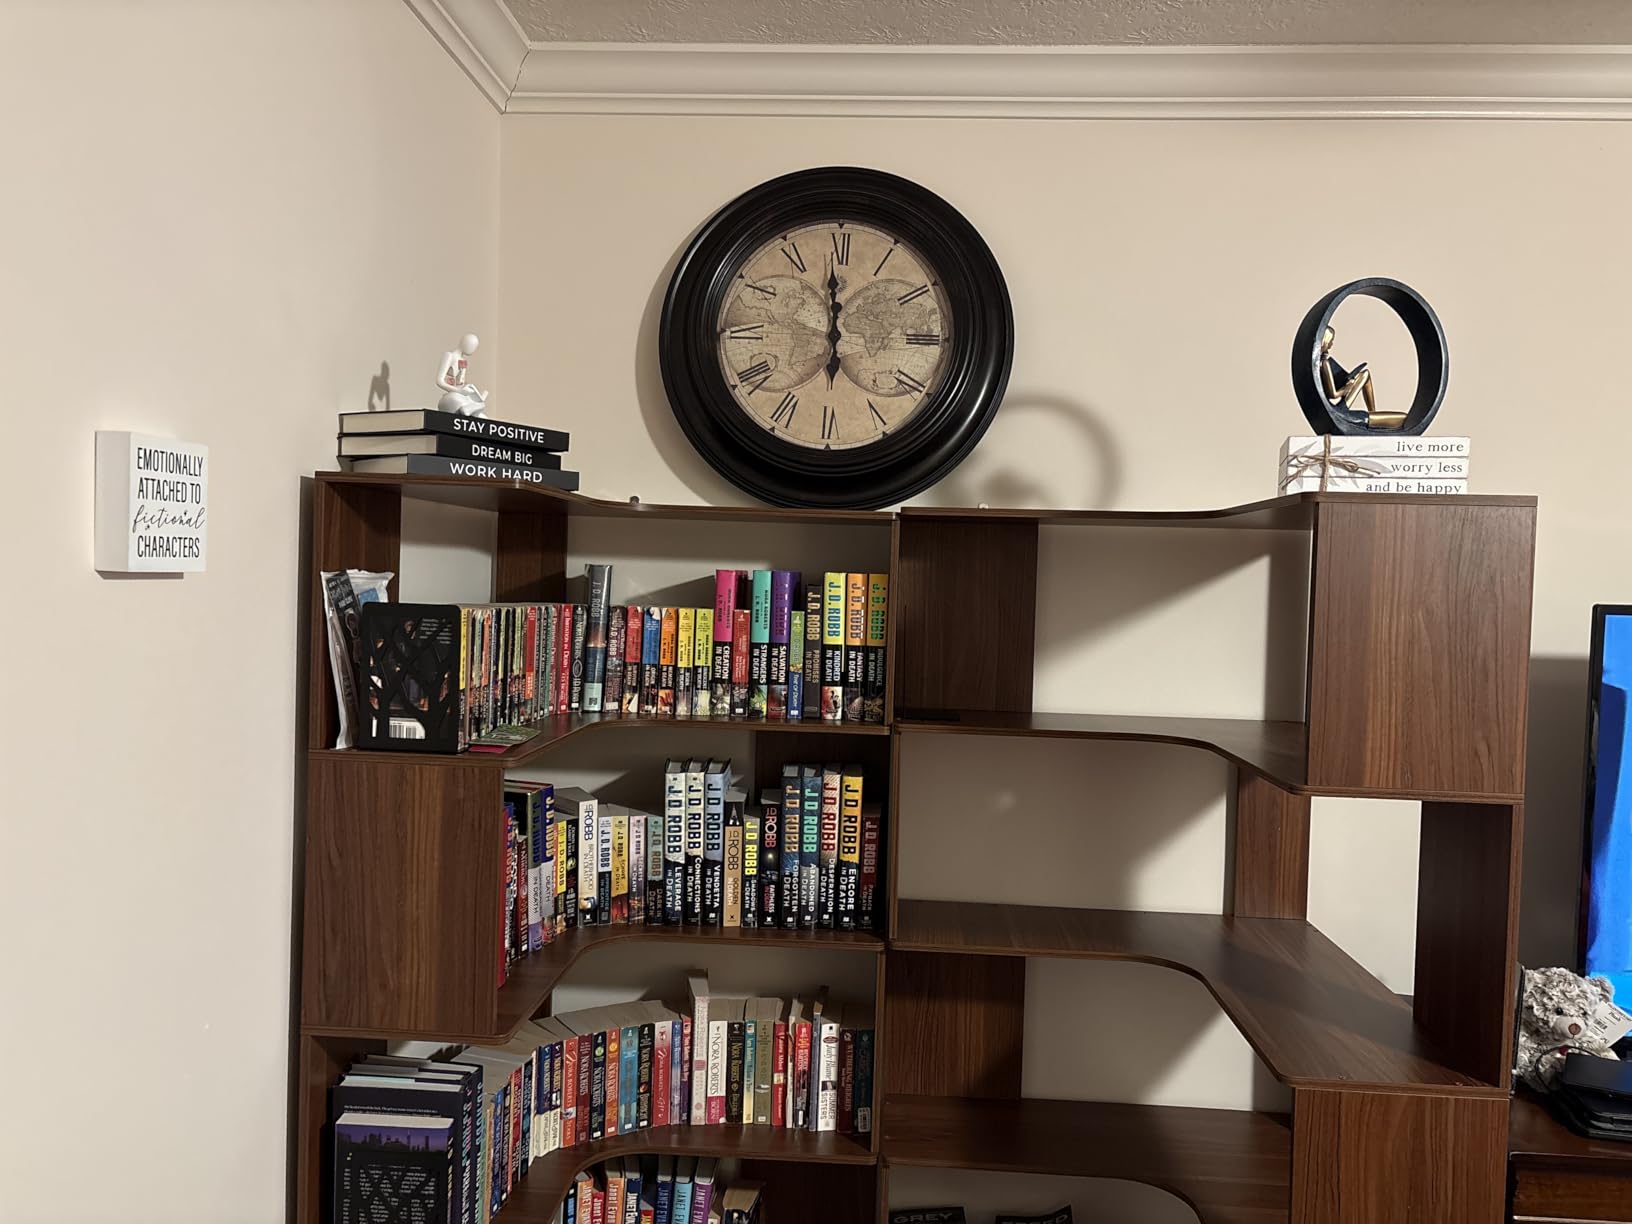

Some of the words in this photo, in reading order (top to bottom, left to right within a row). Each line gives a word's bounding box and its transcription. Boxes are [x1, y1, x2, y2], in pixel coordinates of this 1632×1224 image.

[906, 334, 940, 345] III
[453, 418, 484, 433] STAY
[489, 424, 545, 443] POSITIVE
[472, 444, 511, 461] DREAM
[514, 452, 533, 465] BIG
[1397, 441, 1423, 452] live
[1427, 444, 1464, 452] more
[137, 447, 204, 478] EMOTIONALLY
[449, 462, 497, 479] WORK
[502, 468, 543, 484] HARD
[1391, 464, 1433, 475] worry
[1438, 462, 1463, 473] less
[138, 477, 187, 503] ATTACHED
[190, 483, 201, 504] TO
[1366, 482, 1390, 492] and
[1396, 482, 1412, 492] be
[1417, 482, 1462, 495] happy
[133, 504, 206, 533] fictional
[137, 535, 200, 559] CHARACTERS
[591, 599, 601, 618] ROBB
[828, 608, 841, 637] ROBB
[807, 615, 820, 641] ROBB
[851, 610, 864, 639] ROBB
[871, 610, 886, 640] ROBB
[715, 647, 722, 655] IN
[721, 646, 731, 679] CREATION
[759, 645, 768, 684] STRANGERS
[778, 646, 786, 683] SALVATION
[826, 650, 833, 658] IN
[848, 651, 856, 659] IN
[714, 657, 722, 679] DEATH
[752, 659, 760, 679] DEATH
[771, 659, 779, 680] DEATH
[825, 661, 833, 682] DEATH
[833, 651, 841, 681] KINDRED
[848, 661, 856, 682] DEATH
[584, 811, 594, 841] ROBB
[668, 815, 682, 854] ROBB
[687, 813, 701, 850] ROBB
[706, 814, 721, 851] ROBB
[765, 816, 777, 848] ROBB
[785, 815, 800, 853] ROBB
[804, 816, 818, 853] ROBB
[822, 813, 837, 851] ROBB
[843, 815, 858, 855] ROBB
[600, 848, 609, 868] ROBB
[727, 839, 739, 871] ROBB
[745, 845, 757, 875] ROBB
[694, 858, 702, 913] CONNECTIONS
[784, 868, 790, 876] IN
[827, 858, 835, 913] DESPERATION
[841, 867, 847, 876] IN
[665, 879, 674, 908] DEATH
[674, 867, 682, 912] LEVERAGE
[705, 878, 713, 905] DEATH
[713, 866, 721, 908] VENDETTA
[764, 886, 769, 894] IN
[783, 877, 792, 907] DEATH
[808, 863, 817, 912] ABANDONED
[820, 877, 828, 903] DEATH
[839, 877, 847, 911] DEATH
[847, 869, 856, 911] ENCORE
[711, 1035, 721, 1061] NORA
[710, 1063, 720, 1095] ROBERTS
[820, 1093, 828, 1120] SISTERS
[675, 1190, 687, 1211] JANET
[695, 1187, 706, 1208] JANET
